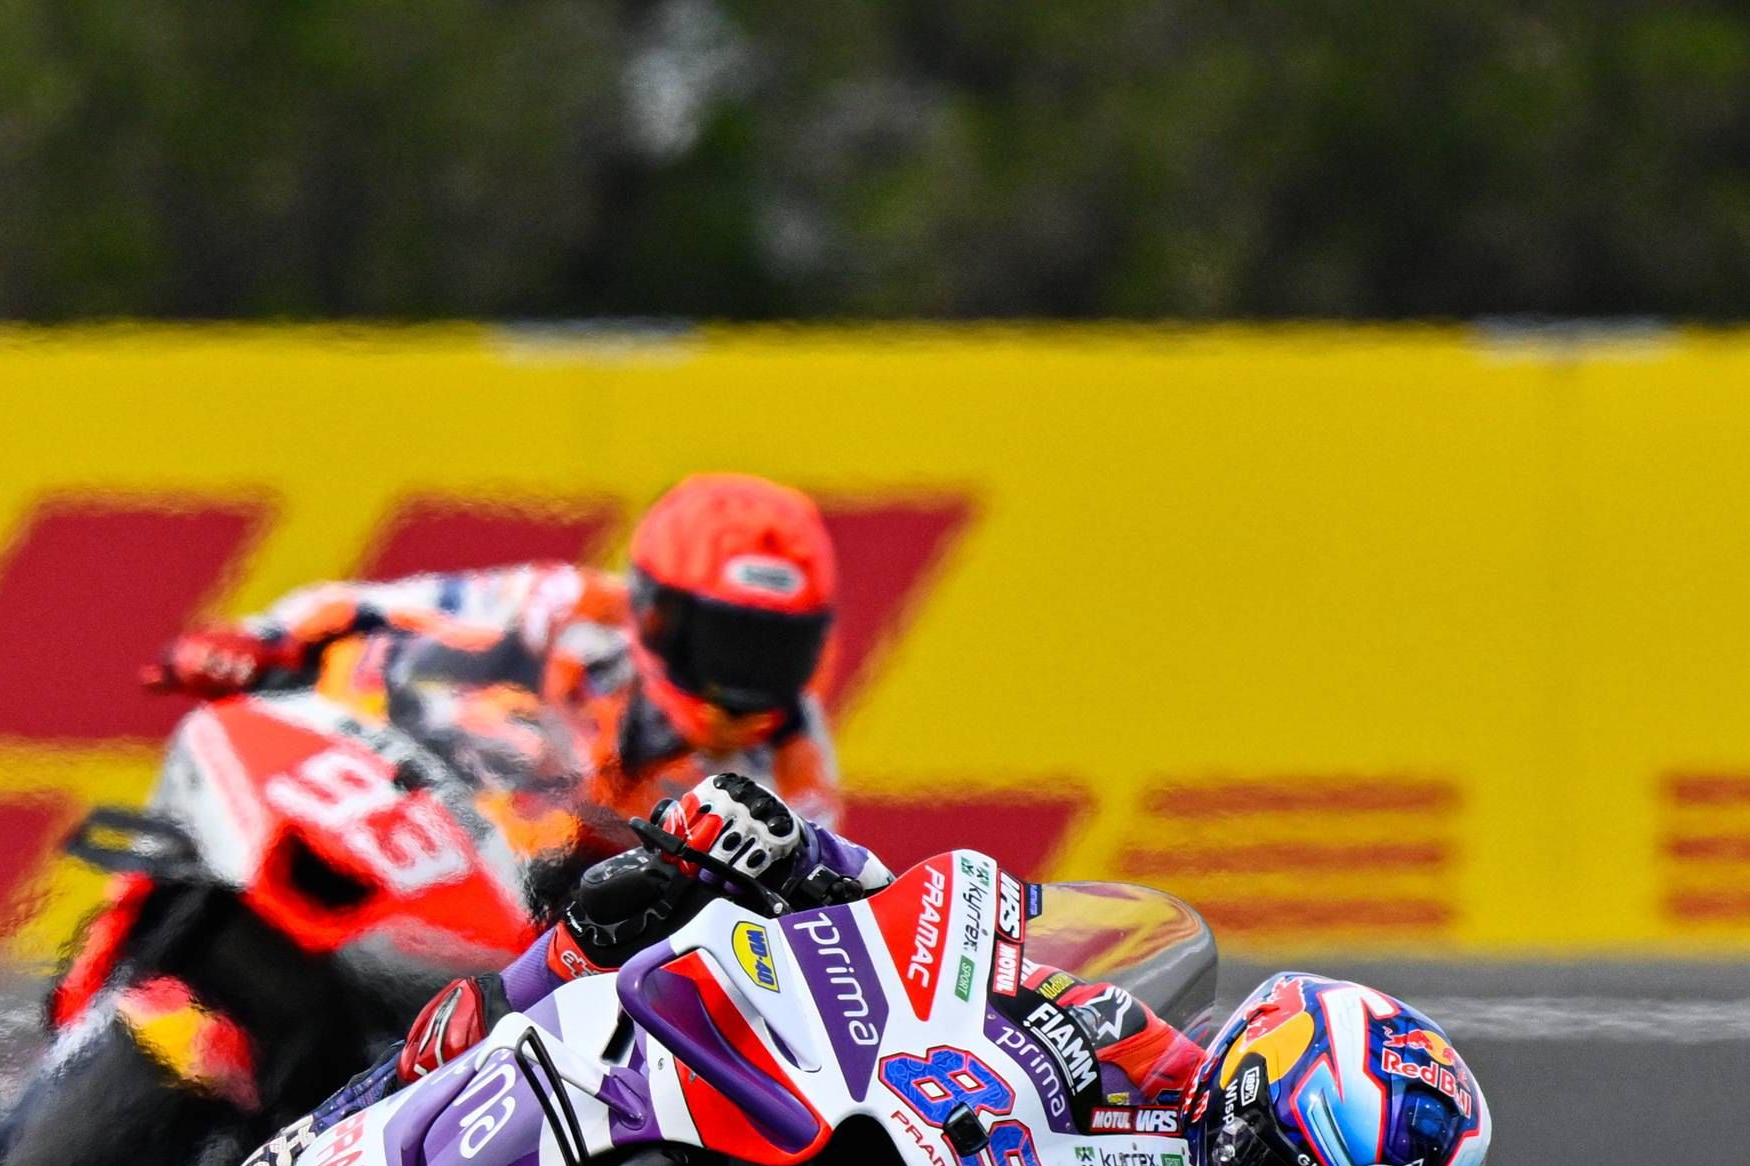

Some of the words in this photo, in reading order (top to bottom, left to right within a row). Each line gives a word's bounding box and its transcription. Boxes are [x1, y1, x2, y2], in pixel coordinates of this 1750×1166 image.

[264, 748, 478, 898] 93
[907, 864, 946, 989] PRAMAC
[961, 880, 989, 952] kyrrex
[744, 927, 775, 987] WD-40
[793, 911, 881, 1047] prima
[956, 962, 974, 1001] SPORT
[995, 942, 1018, 993] MOTUL
[995, 1026, 1066, 1118] prima
[1026, 1001, 1099, 1094] FIAMM
[1380, 1047, 1439, 1088] Red
[1091, 1110, 1132, 1130] MOTUL
[1135, 1108, 1179, 1133] WRS
